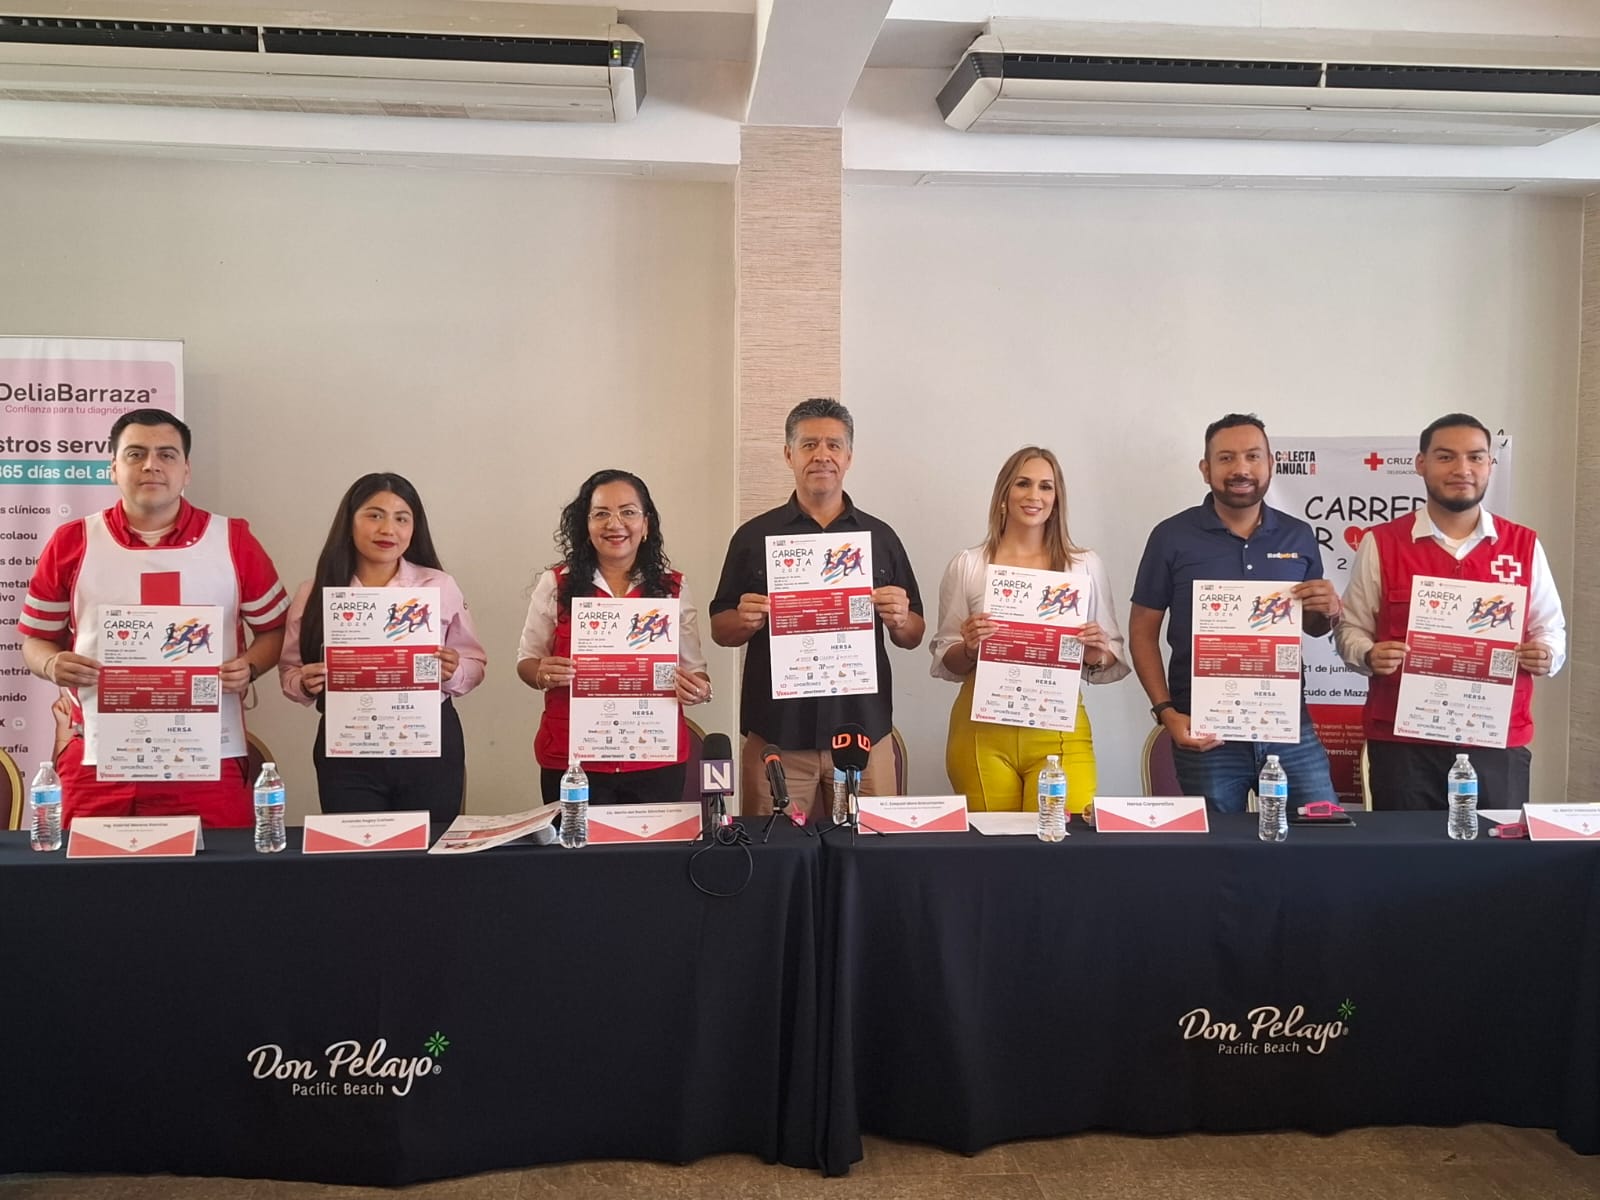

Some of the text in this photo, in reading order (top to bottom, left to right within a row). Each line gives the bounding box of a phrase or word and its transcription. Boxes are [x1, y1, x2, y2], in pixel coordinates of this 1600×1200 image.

[5, 405, 52, 414] Confianza
[53, 406, 73, 416] para
[75, 406, 87, 414] tu
[28, 464, 61, 479] días
[64, 465, 92, 480] del
[1276, 463, 1308, 475] ANUAL
[8, 505, 51, 514] clínicos
[772, 548, 814, 558] CARRERA
[8, 557, 22, 566] de
[991, 579, 1033, 590] CARRERA
[1199, 594, 1242, 602] CARRERA
[1417, 590, 1462, 602] CARRERA
[330, 602, 376, 611] CARRERA
[578, 611, 620, 620] CARRERA
[104, 620, 153, 630] CARRERA
[1315, 665, 1327, 673] de
[1329, 689, 1341, 697] de
[1178, 1008, 1242, 1041] Don
[1218, 1042, 1300, 1055] Pacific Beach
[247, 1044, 318, 1080] Don
[292, 1082, 385, 1096] Pacific Beach
